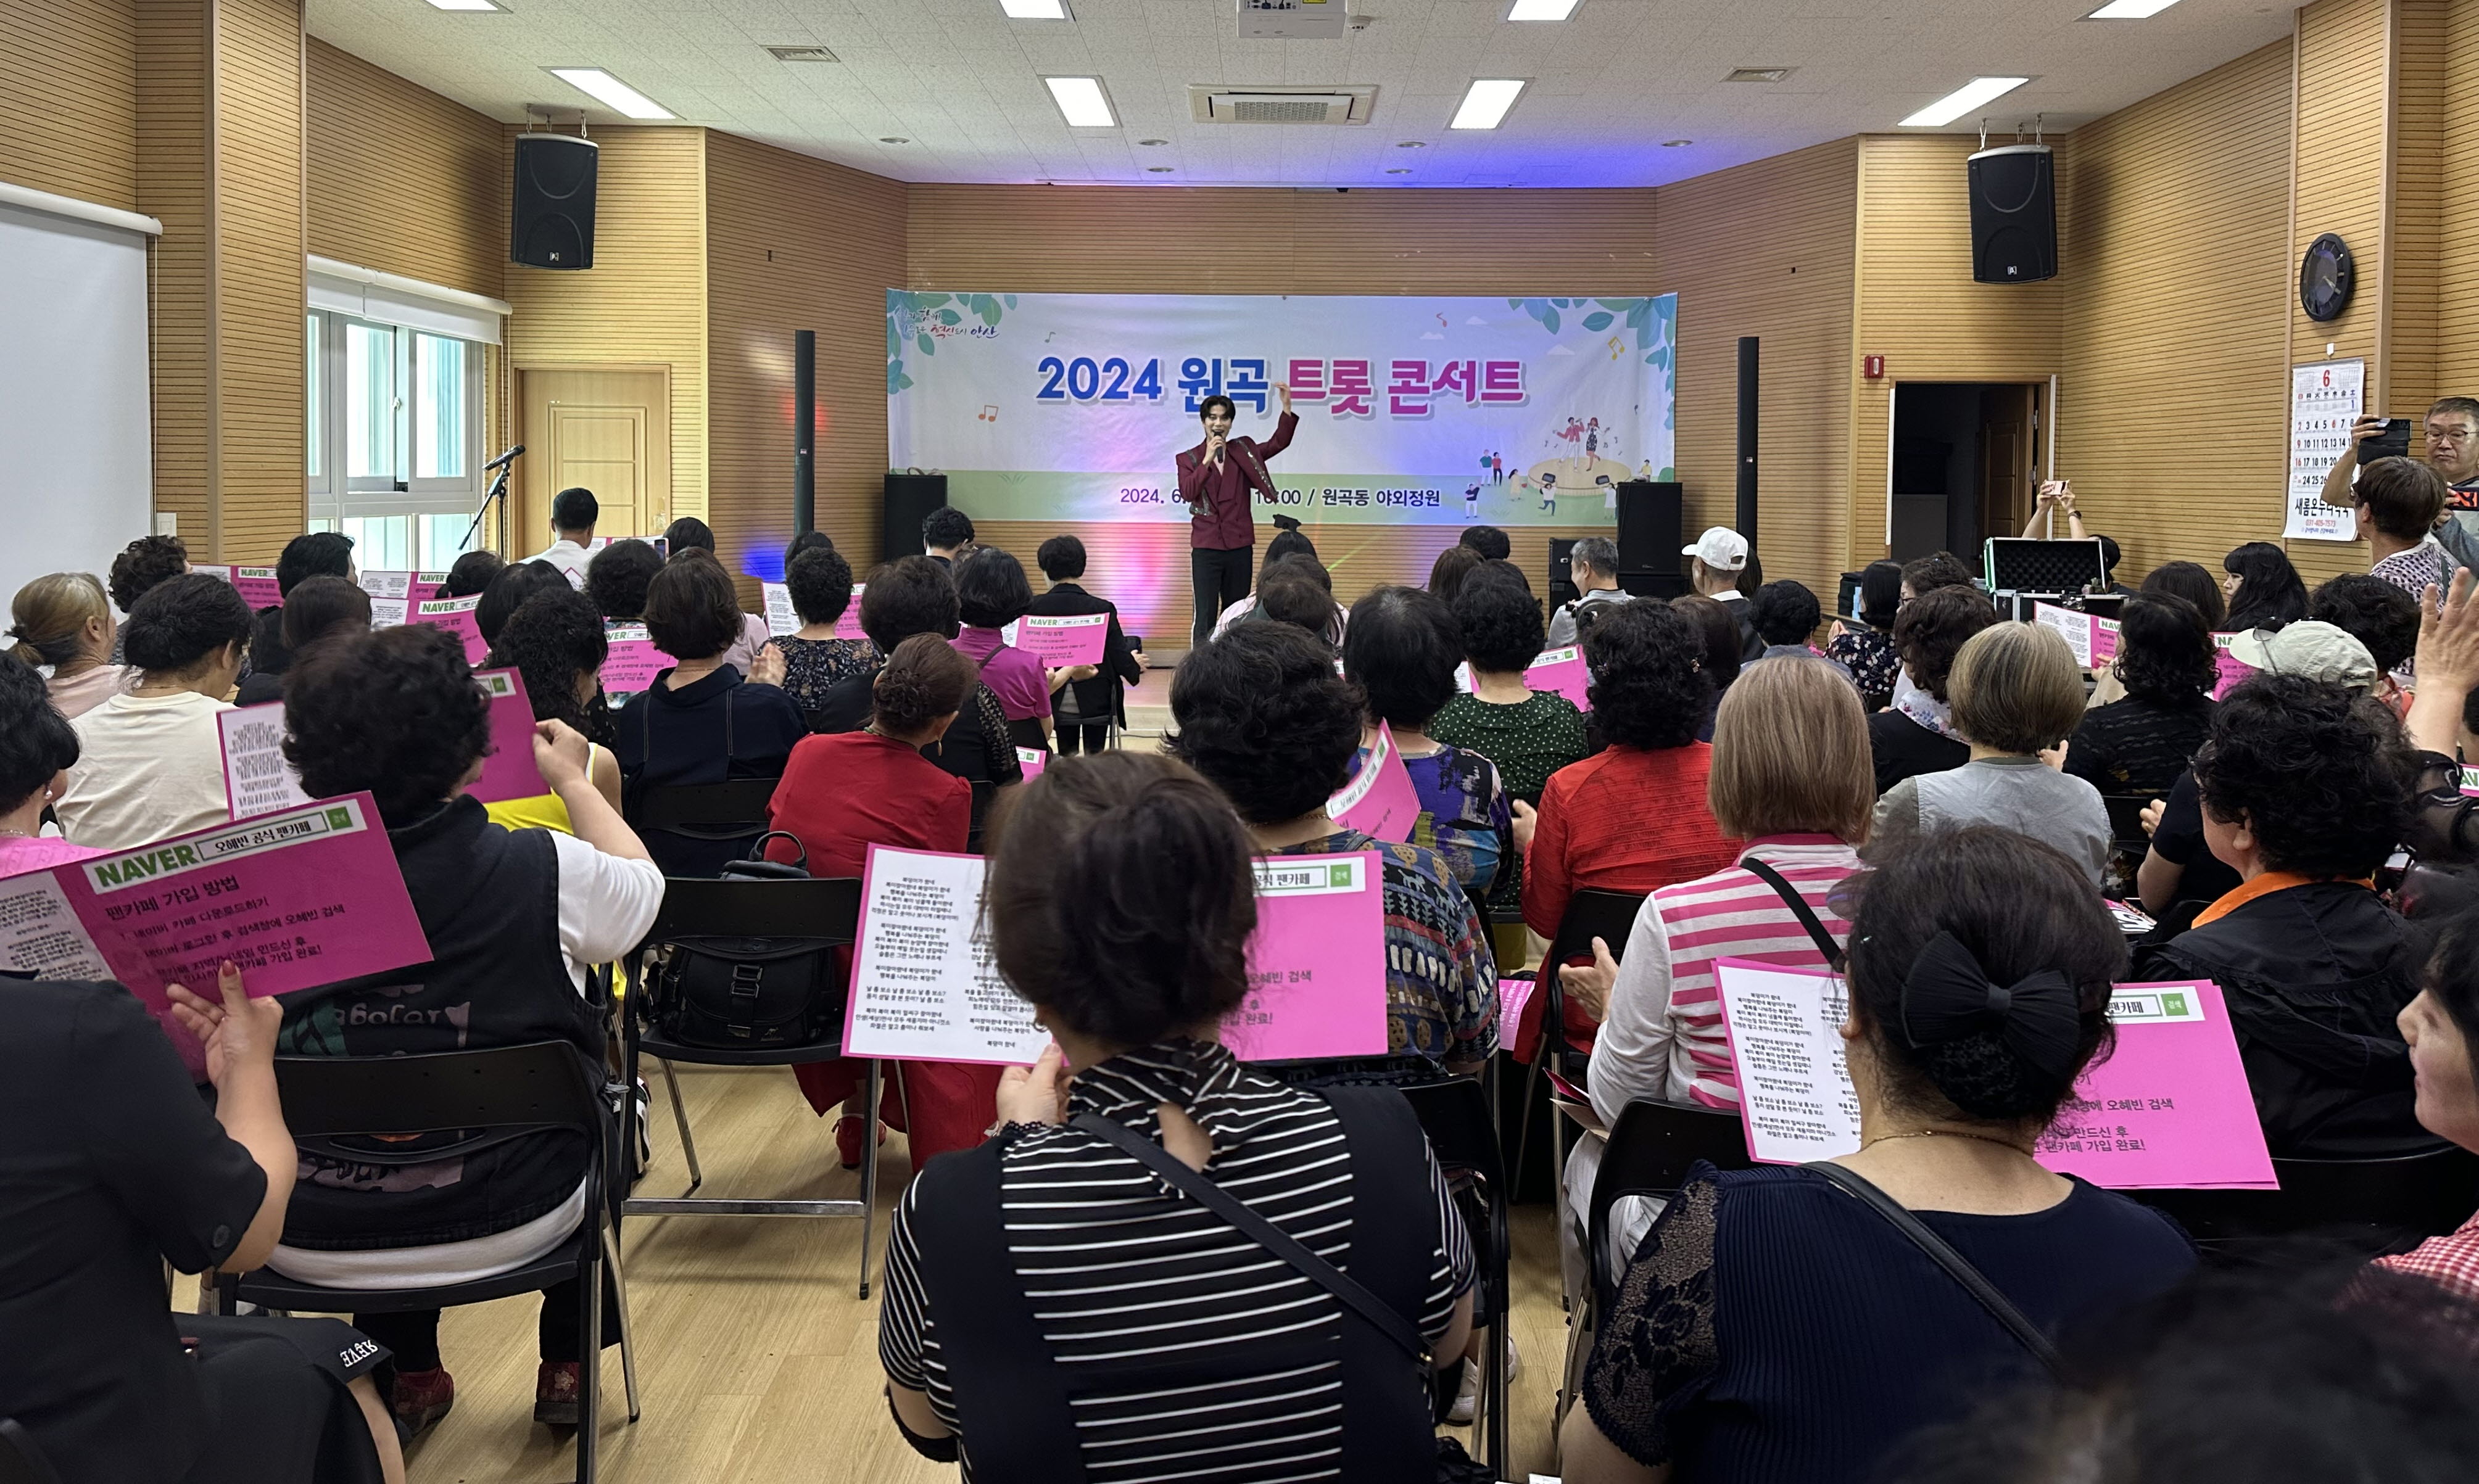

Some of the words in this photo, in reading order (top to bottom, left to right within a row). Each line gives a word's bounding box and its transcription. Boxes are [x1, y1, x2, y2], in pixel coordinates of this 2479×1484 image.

[930, 324, 967, 339] 혁신도시
[970, 326, 1000, 339] 안산
[2323, 369, 2330, 387] 6
[1036, 357, 1162, 400] 2024
[1178, 358, 1268, 413] 원곡
[1289, 360, 1372, 414] 트롯
[1388, 360, 1523, 414] 콘서트
[2298, 421, 2302, 430] 2
[2306, 421, 2310, 430] 3
[2314, 420, 2319, 429] 4
[2323, 419, 2327, 429] 5
[2332, 419, 2336, 428] 6
[2341, 419, 2345, 428] 7
[2297, 439, 2301, 448] 9
[2304, 439, 2311, 448] 10
[2313, 439, 2319, 448] 11
[2321, 438, 2328, 448] 12
[2330, 437, 2337, 447] 13
[2339, 437, 2346, 447] 14
[2295, 457, 2302, 467] 16
[2303, 457, 2310, 467] 17
[2312, 457, 2319, 466] 18
[2321, 456, 2328, 466] 19
[2330, 456, 2337, 466] 20
[2303, 476, 2310, 485] 24
[2312, 475, 2319, 484] 25
[1120, 488, 1164, 504] 2024.
[1322, 488, 1370, 506] 원곡동
[1376, 489, 1440, 506] 야외정원
[241, 569, 268, 577] NAVER
[422, 601, 455, 612] NAVER
[607, 631, 627, 640] VER
[215, 835, 249, 854] 오혜빈
[250, 829, 276, 844] 공식
[276, 821, 312, 838] 팬카페
[94, 844, 200, 887] NAVER
[1277, 873, 1310, 886] 팬카페
[106, 896, 160, 921] 팬카페
[162, 884, 200, 906] 가입
[202, 874, 240, 896] 방법
[199, 896, 270, 921] 다운로드하기
[286, 909, 318, 925] 오혜빈
[321, 904, 346, 917] 검색
[295, 936, 307, 947] 후
[270, 950, 293, 963] 가입
[296, 944, 323, 959] 완료!
[1288, 970, 1312, 983] 검색
[1250, 999, 1260, 1010] 후
[1245, 1012, 1273, 1026] 완료!
[2107, 1099, 2145, 1111] 오혜빈
[2148, 1097, 2174, 1110] 검색
[2074, 1126, 2112, 1139] 만드신
[2116, 1125, 2129, 1138] 후
[2045, 1140, 2084, 1153] 팬카페
[2087, 1140, 2113, 1152] 가입
[2115, 1139, 2146, 1152] 완료!
